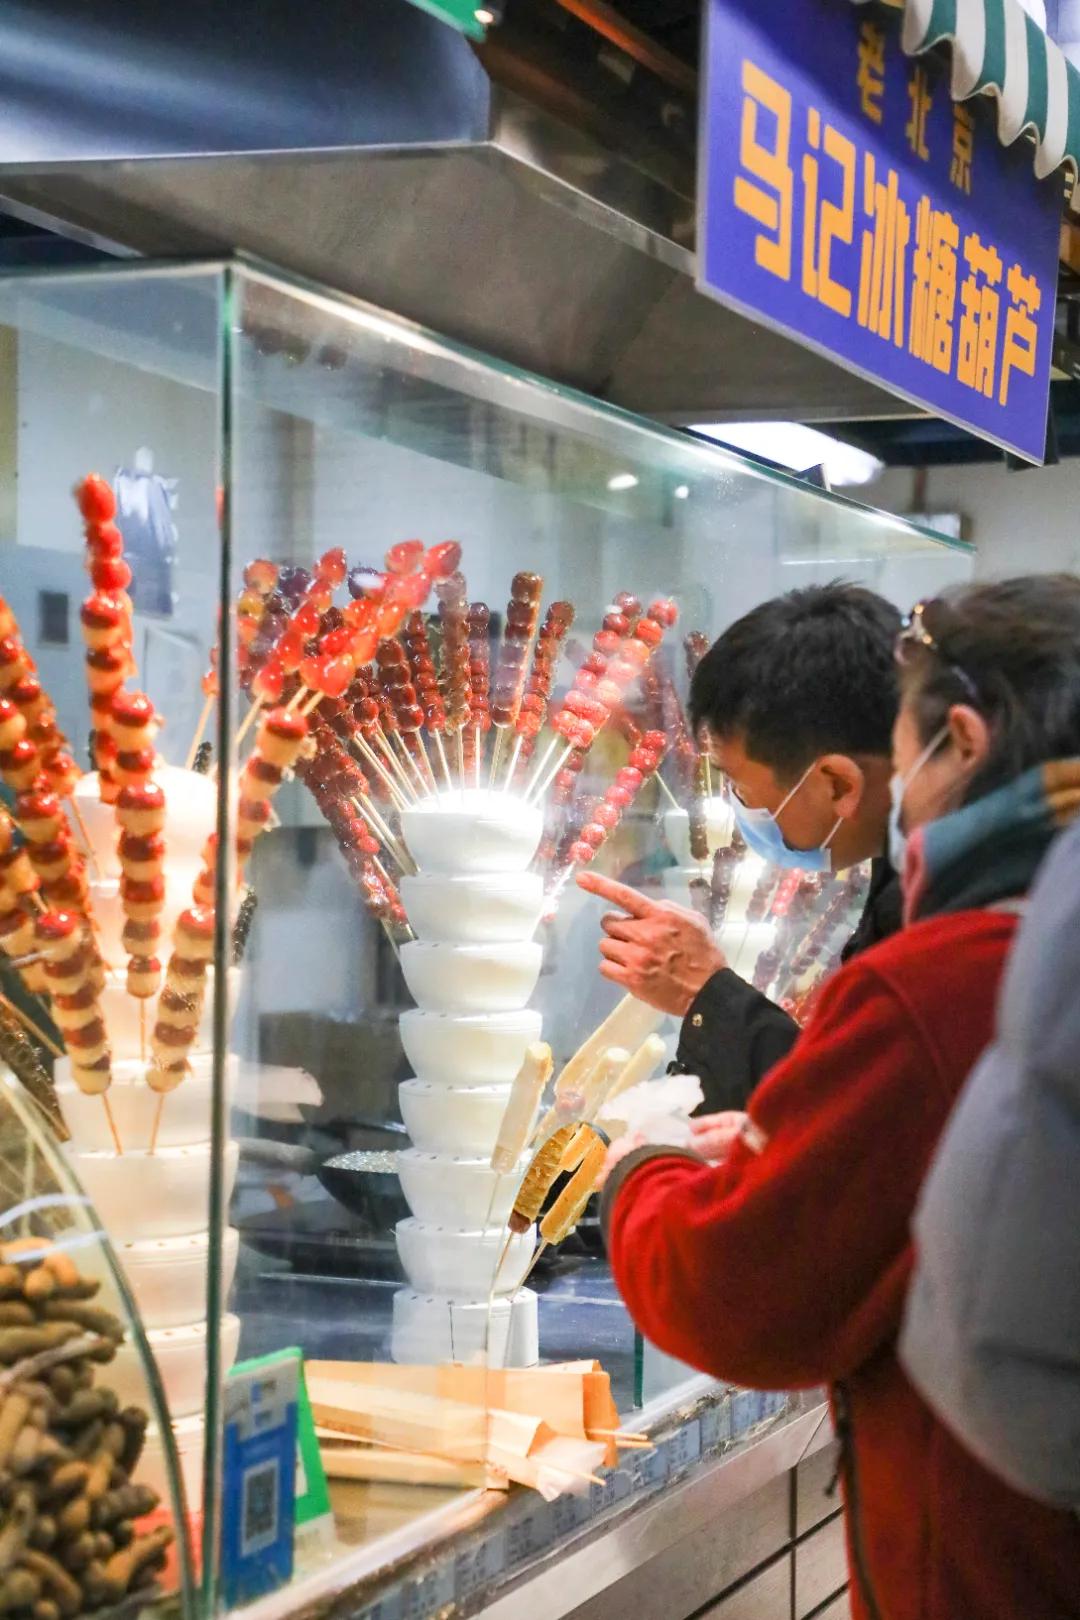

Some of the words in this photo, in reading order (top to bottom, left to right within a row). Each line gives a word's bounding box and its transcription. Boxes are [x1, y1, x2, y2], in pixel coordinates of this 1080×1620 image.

[733, 58, 1042, 407] 马记冰糖葫芦
[857, 20, 975, 196] 老北京
